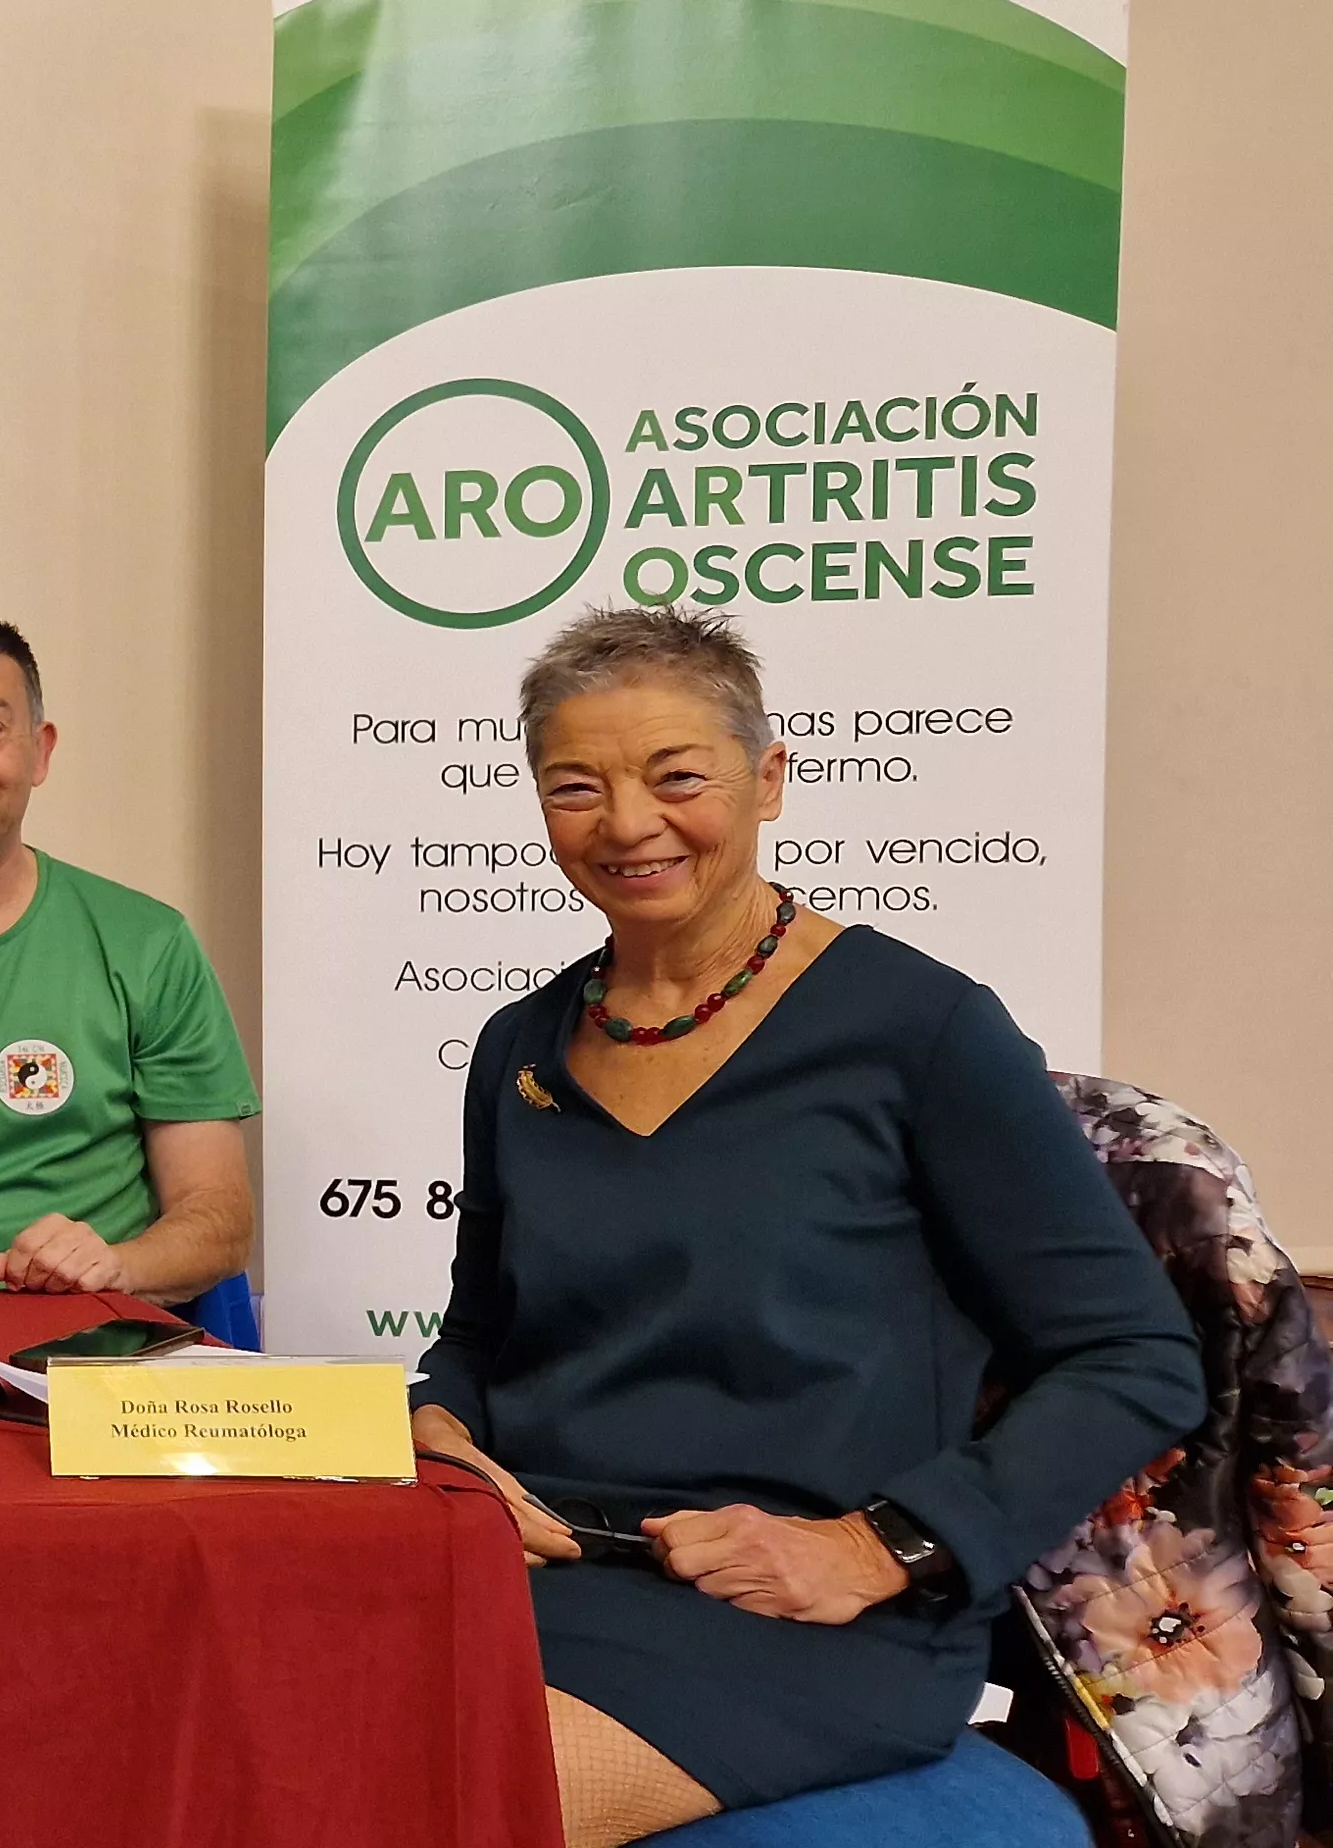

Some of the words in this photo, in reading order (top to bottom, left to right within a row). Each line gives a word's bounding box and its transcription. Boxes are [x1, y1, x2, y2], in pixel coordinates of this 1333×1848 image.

[625, 382, 1038, 453] ASOCIACIÓN
[364, 464, 583, 543] ARO
[625, 452, 1037, 529] ARTRITIS
[623, 535, 1035, 606] OSCENSE
[353, 713, 436, 744] Para
[458, 718, 527, 742] mu
[767, 711, 835, 737] nas
[854, 707, 1013, 743] parece
[441, 763, 519, 795] que
[785, 751, 918, 783] fermo.
[318, 837, 392, 875] Hoy
[774, 839, 846, 872] por
[866, 831, 1047, 867] vencido,
[420, 881, 584, 913] nosotros
[319, 1178, 402, 1219] 675
[426, 1180, 454, 1220] 8
[121, 1398, 168, 1415] Doña
[174, 1400, 219, 1414] Rosa
[225, 1399, 293, 1414] Rosello
[111, 1422, 177, 1439] Médico
[183, 1422, 307, 1443] Reumatóloga
